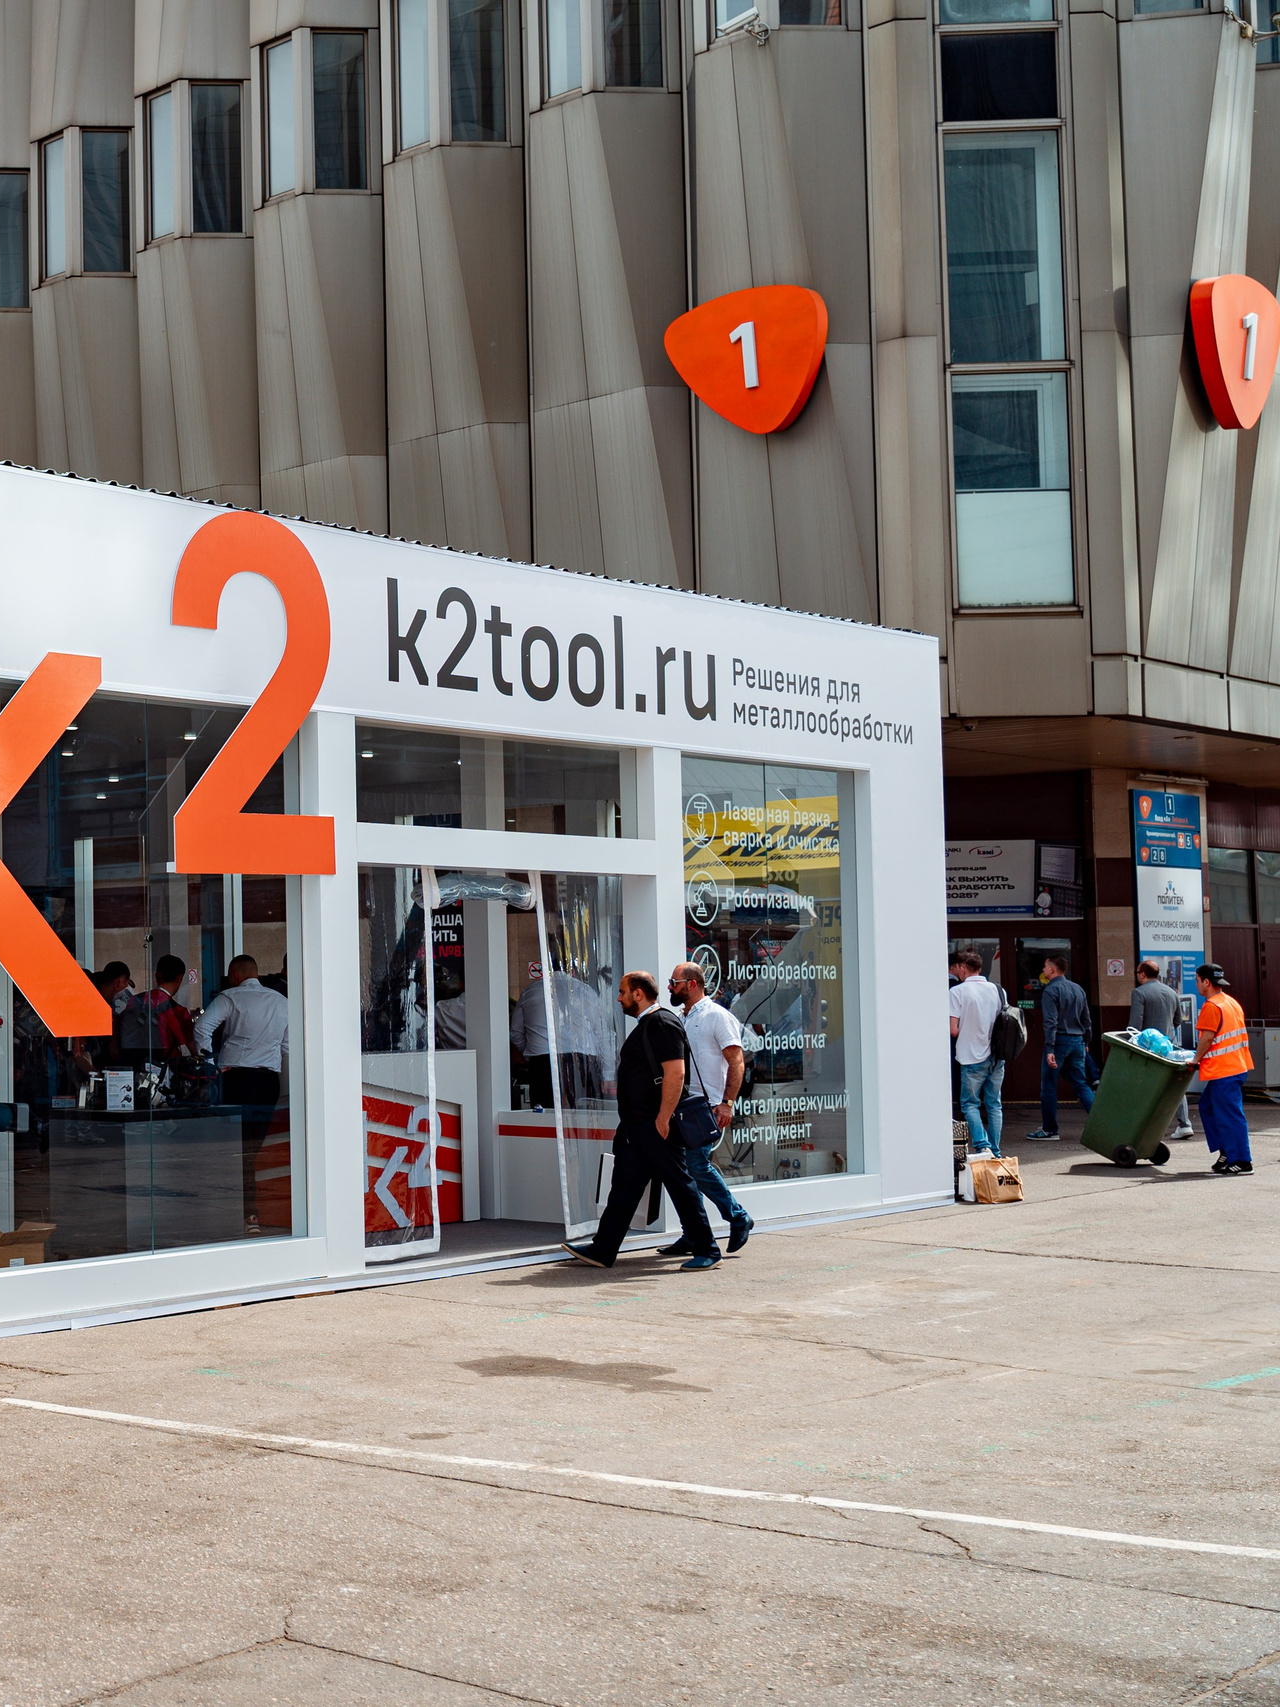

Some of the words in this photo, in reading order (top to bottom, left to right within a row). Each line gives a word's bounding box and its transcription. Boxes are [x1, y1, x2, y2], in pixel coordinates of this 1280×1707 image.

[729, 321, 760, 389] 1
[1242, 312, 1259, 381] 1
[387, 577, 716, 721] k2tool.ru
[732, 657, 820, 698] Решения
[827, 679, 861, 705] для
[733, 699, 913, 745] металлообработки
[722, 800, 790, 826] Лазерная
[793, 809, 836, 831] резка,
[723, 830, 773, 851] сварка
[777, 836, 785, 847] и
[788, 835, 840, 853] очистка
[1186, 836, 1191, 846] 5
[1153, 850, 1158, 861] 2
[1160, 851, 1165, 861] 8
[726, 887, 815, 912] Роботизация
[431, 913, 464, 927] АША
[1142, 920, 1178, 929] КОРПОРАТИВНОЕ
[1179, 921, 1200, 930] ОБУЧЕНИЕ
[432, 930, 458, 942] ИТЬ
[438, 944, 465, 958] №8
[727, 960, 837, 983] Листообработка
[742, 1030, 826, 1054] ехобработка
[732, 1088, 850, 1116] Металлорежущий
[732, 1122, 813, 1145] инструмент
